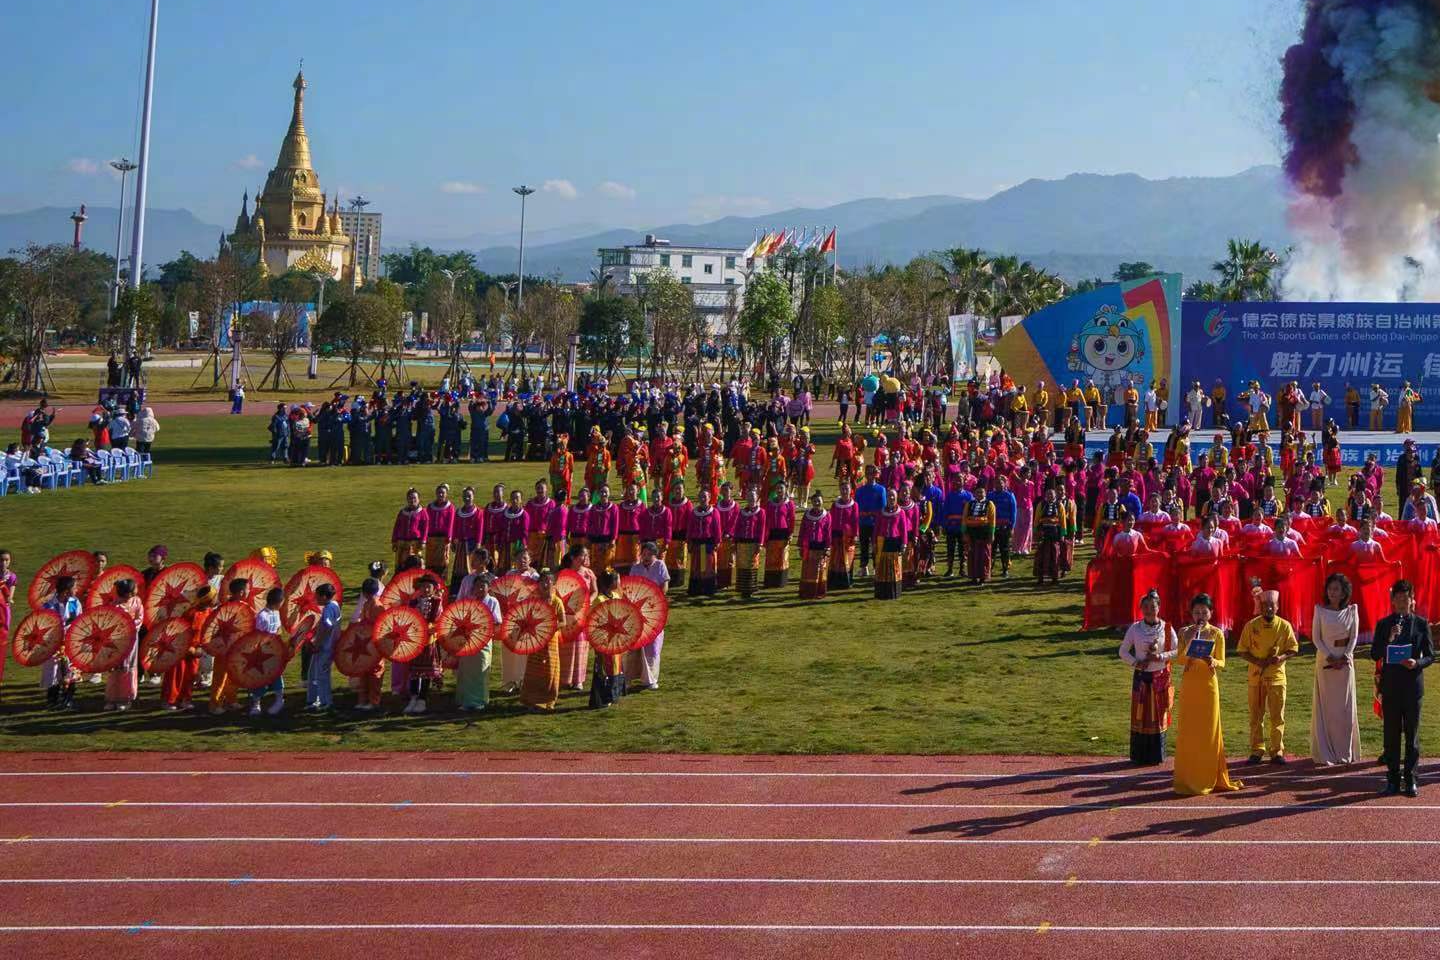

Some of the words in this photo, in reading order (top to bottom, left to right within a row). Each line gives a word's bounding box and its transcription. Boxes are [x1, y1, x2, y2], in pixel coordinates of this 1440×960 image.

[1242, 331, 1258, 340] The
[1262, 331, 1275, 340] 3rd
[1278, 331, 1306, 341] Sports
[1309, 332, 1339, 340] Games
[1341, 331, 1350, 340] of
[1353, 332, 1388, 342] Dehong
[1269, 351, 1404, 377] 魅力州运
